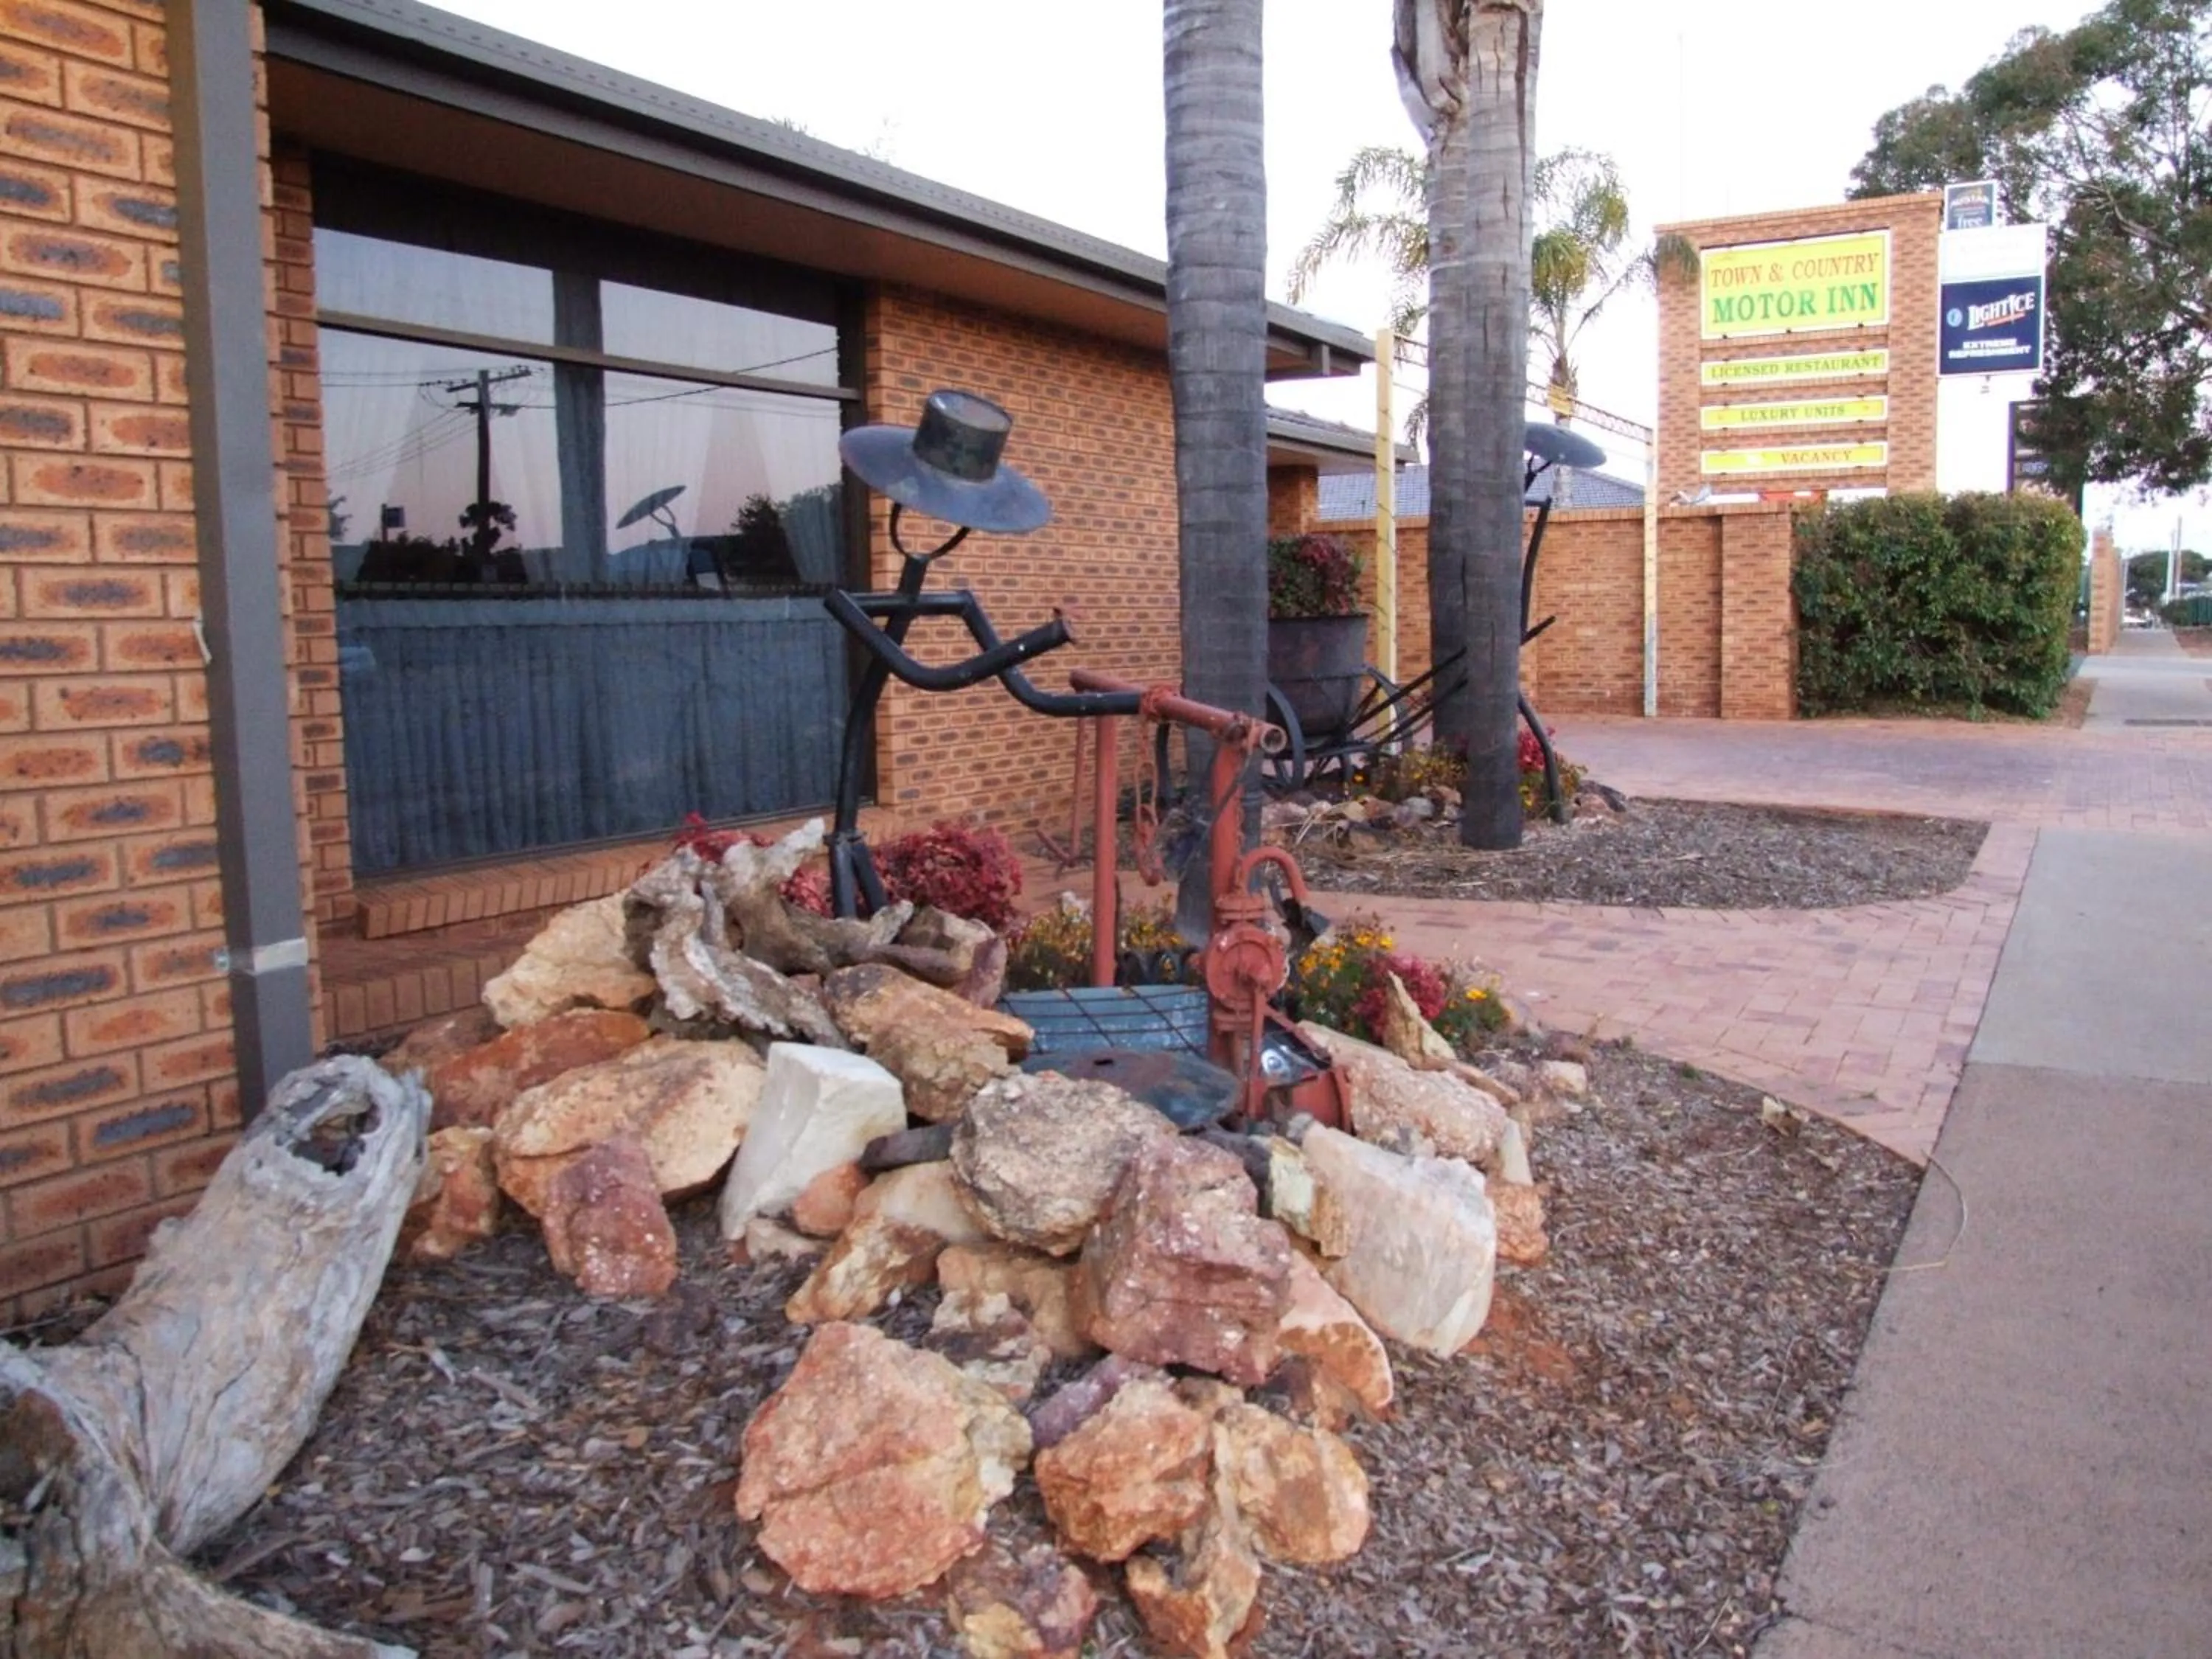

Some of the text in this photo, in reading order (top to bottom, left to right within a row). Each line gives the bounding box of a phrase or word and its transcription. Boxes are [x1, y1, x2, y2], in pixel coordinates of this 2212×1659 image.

[1711, 252, 1880, 289] TOWN & COUNTRY
[1712, 282, 1879, 324] MOTOR INN
[1711, 354, 1880, 378] LICENSED RESTAURANT
[1741, 404, 1846, 421] LUXURY UNITS
[1781, 451, 1852, 465] VACANCY
